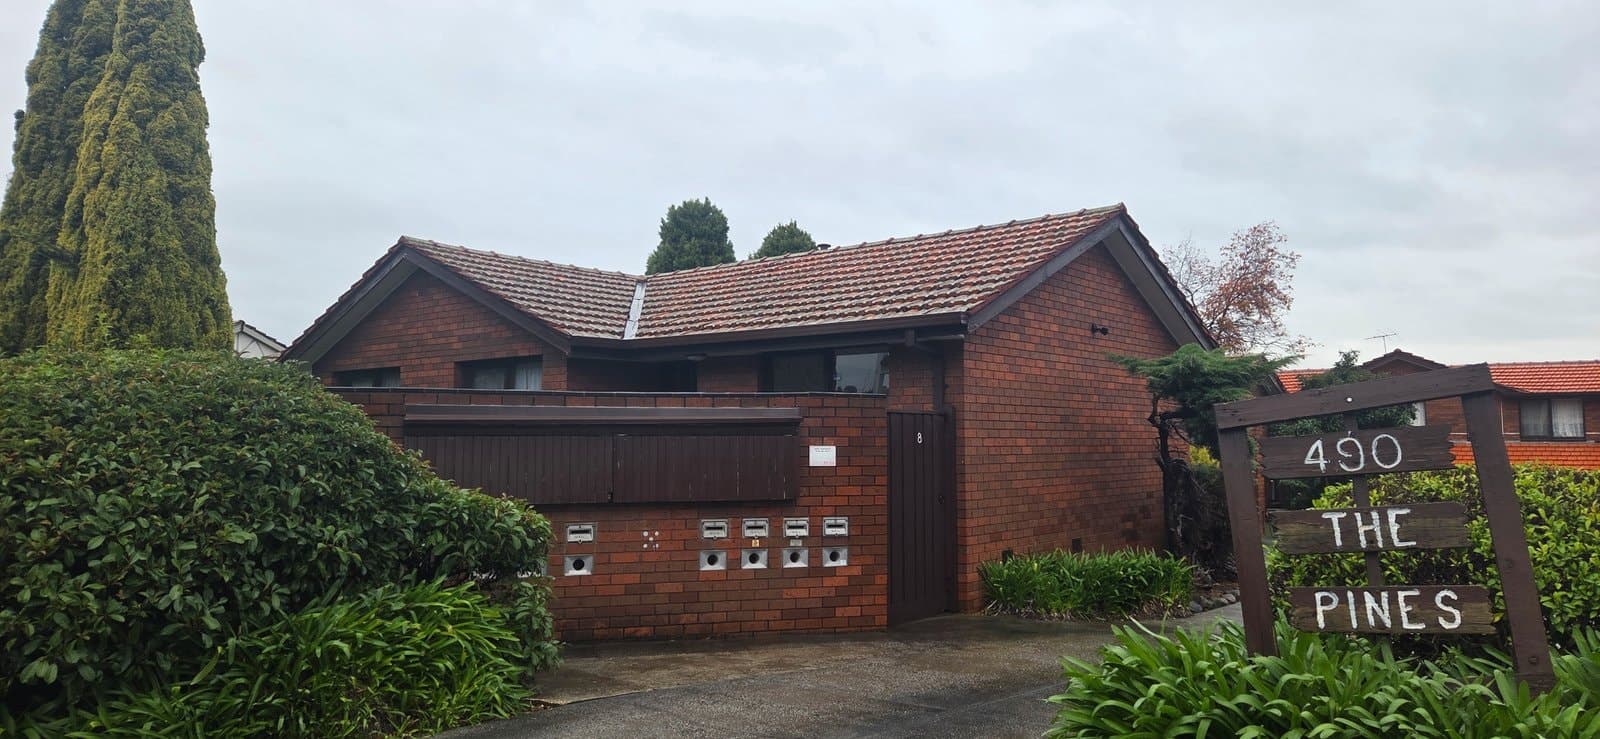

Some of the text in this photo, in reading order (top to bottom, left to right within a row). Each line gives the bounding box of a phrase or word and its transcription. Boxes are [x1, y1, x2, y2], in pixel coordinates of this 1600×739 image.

[917, 432, 923, 444] 8
[1303, 433, 1403, 474] 490
[1321, 508, 1417, 549] THE
[1314, 588, 1462, 630] PINES
